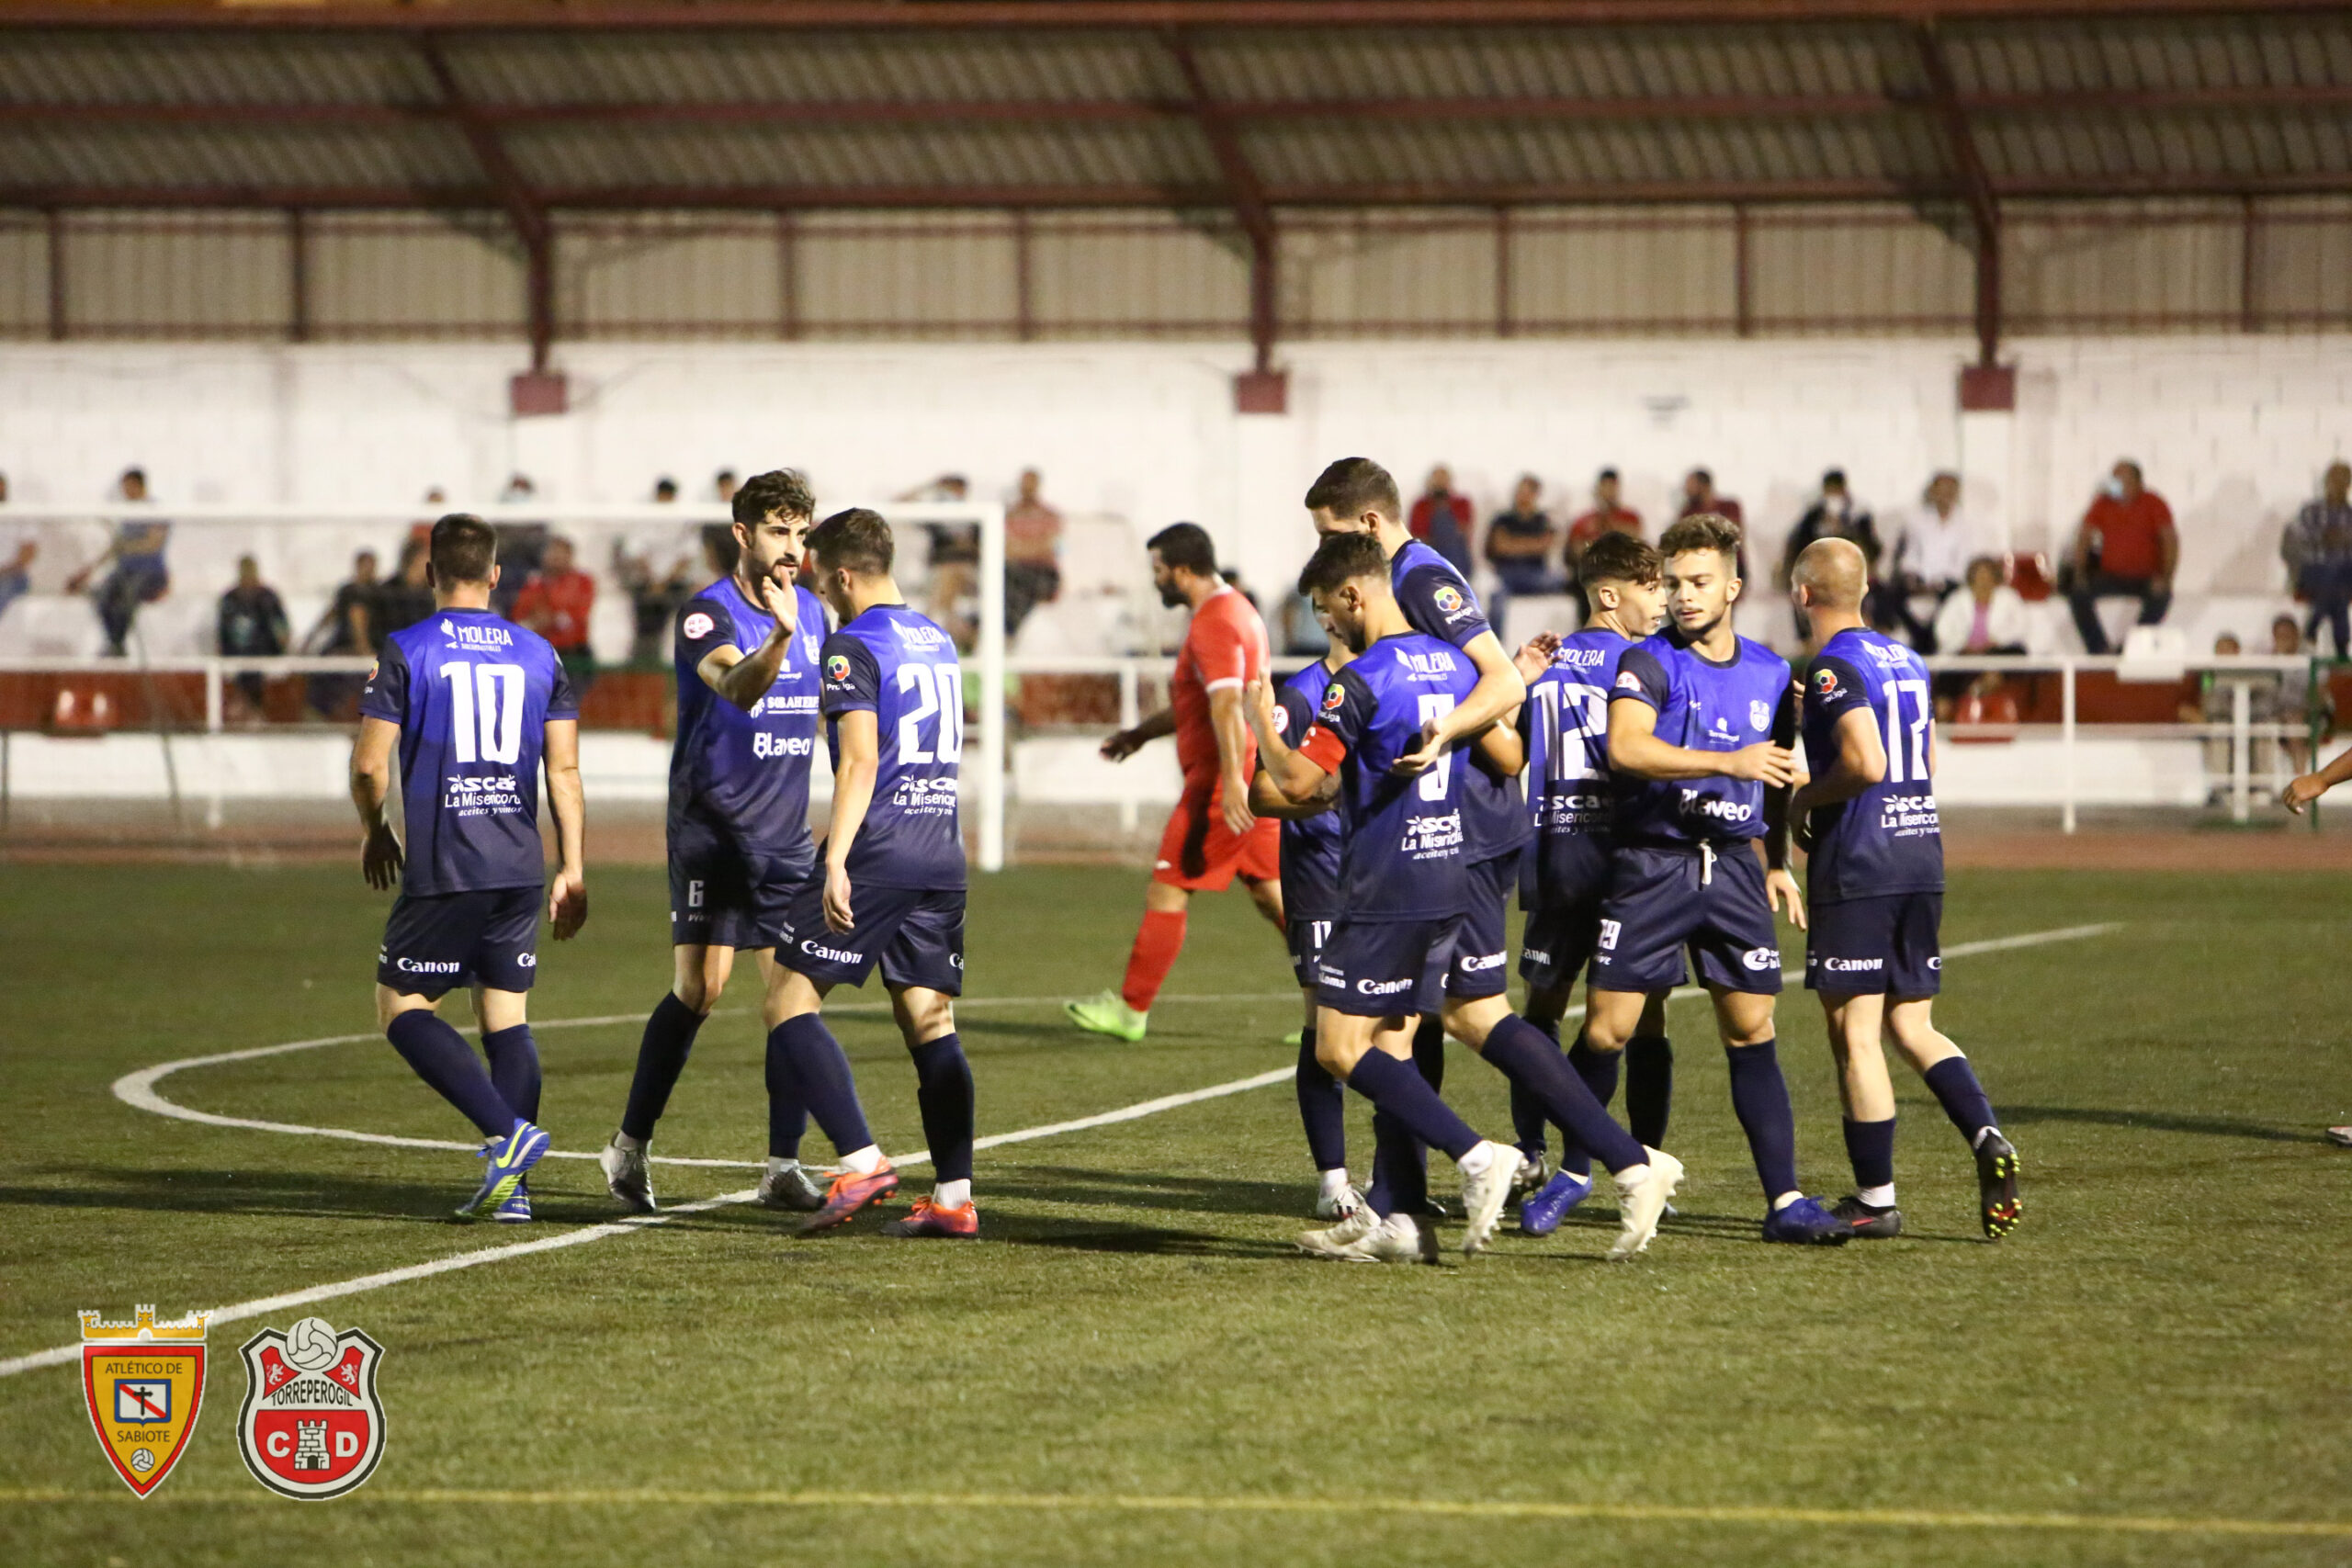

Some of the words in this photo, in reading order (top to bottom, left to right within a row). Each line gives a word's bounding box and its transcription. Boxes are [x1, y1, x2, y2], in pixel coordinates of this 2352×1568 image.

[457, 626, 514, 647] MOLERA
[439, 661, 526, 765] 10
[896, 662, 964, 766] 20
[1532, 680, 1610, 781] 12
[1882, 680, 1929, 784] 17
[753, 732, 810, 761] Blaveo
[444, 793, 460, 808] La
[893, 786, 908, 807] La
[1679, 788, 1752, 822] Blaveo
[458, 806, 489, 817] aceites
[490, 807, 498, 817] y
[498, 805, 523, 815] vinos
[1881, 814, 1899, 829] La
[1401, 837, 1418, 852] La
[688, 879, 704, 908] 6
[800, 940, 864, 964] Canon
[397, 956, 460, 974] Canon
[1824, 957, 1884, 972] Canon
[1357, 977, 1413, 996] Canon
